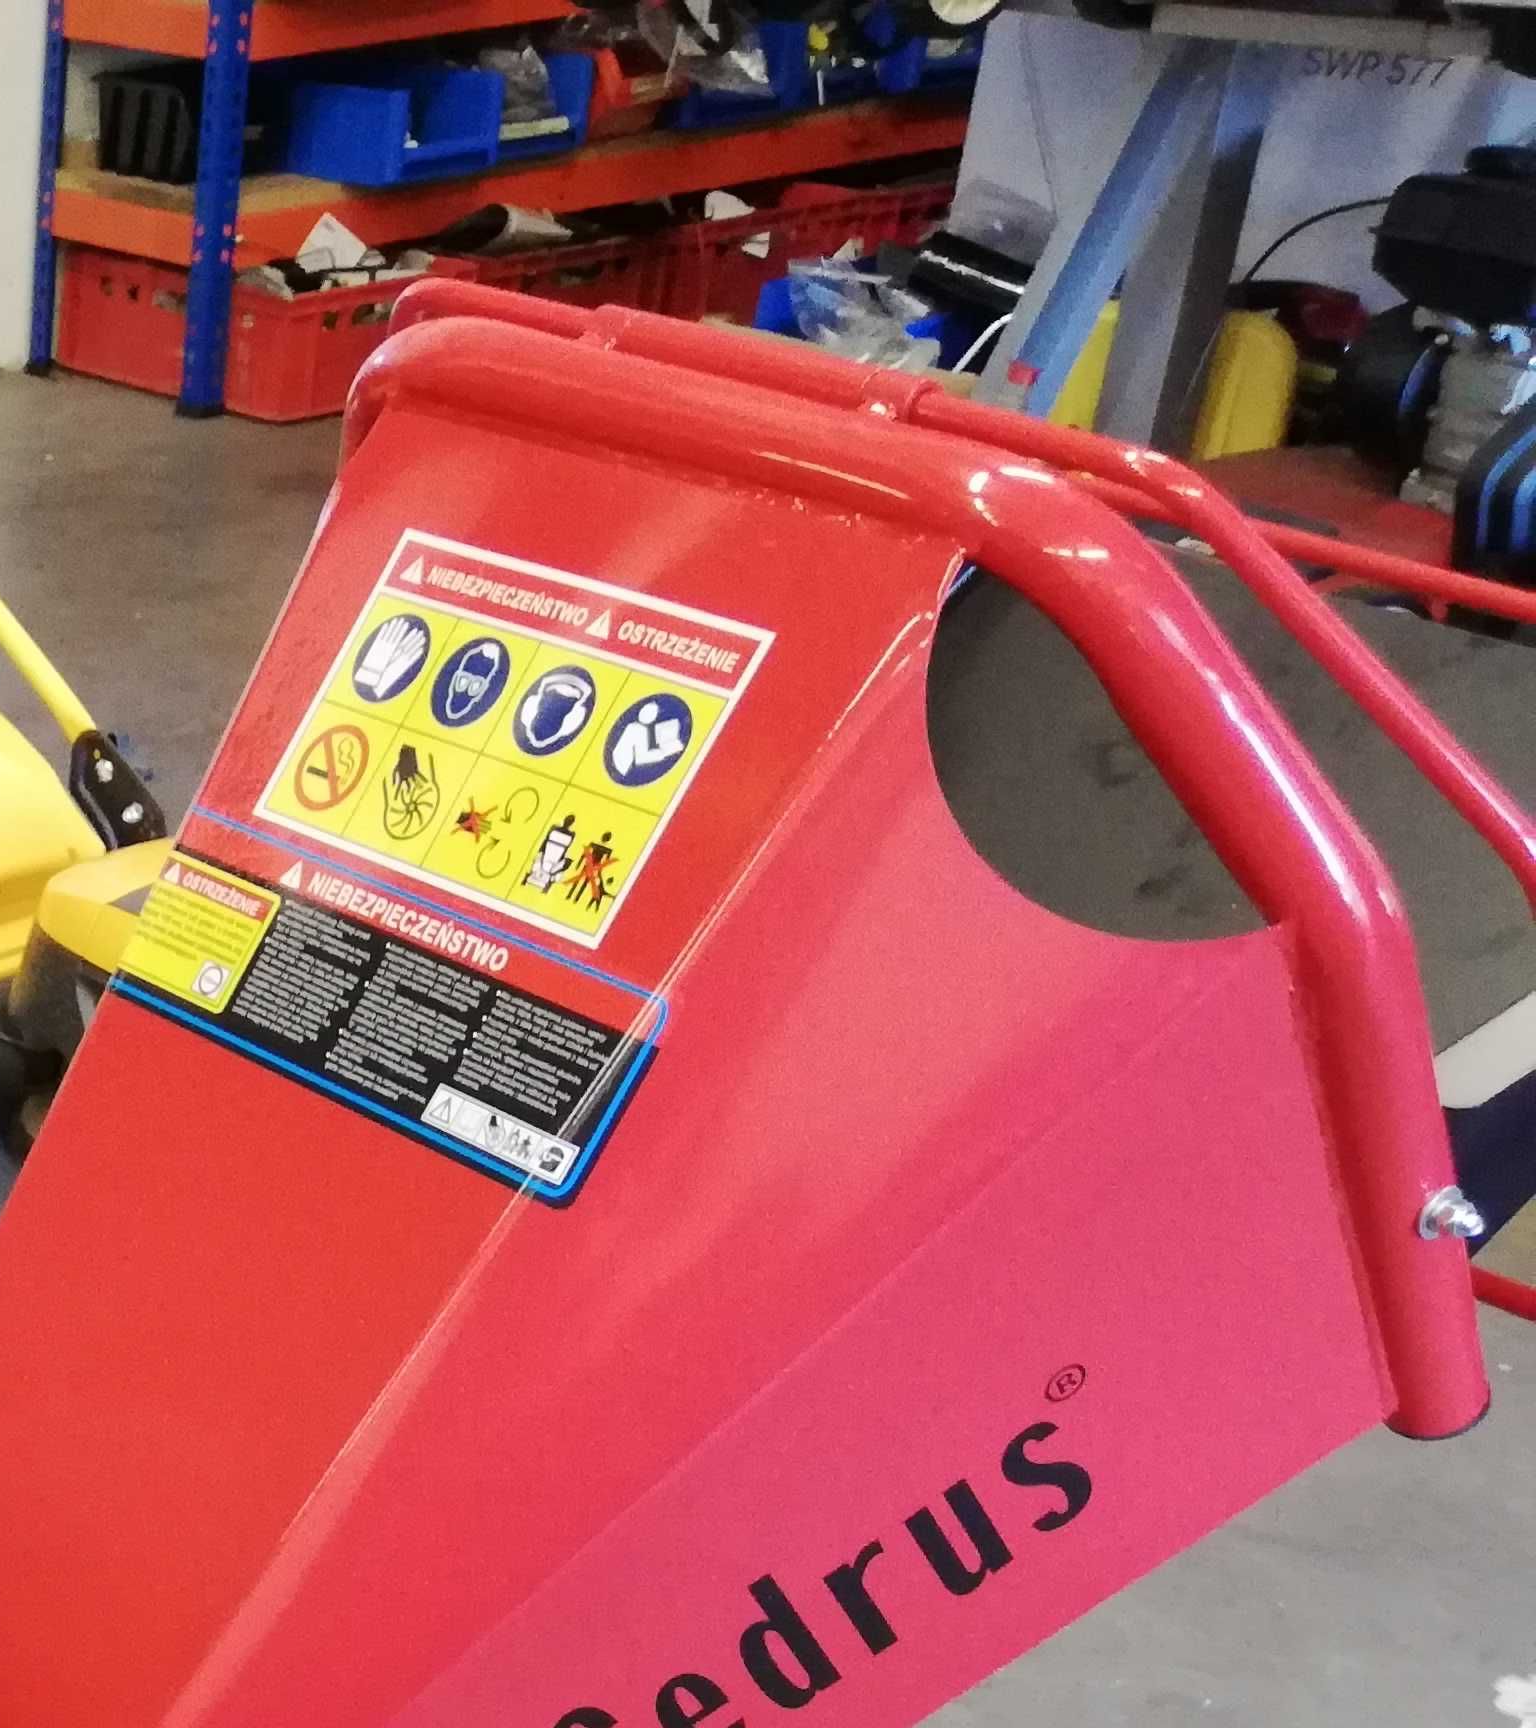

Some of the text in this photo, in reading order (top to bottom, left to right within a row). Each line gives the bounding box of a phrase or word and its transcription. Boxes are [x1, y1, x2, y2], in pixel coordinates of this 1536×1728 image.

[426, 564, 741, 674] NIEBEZPIECZEŃSTWO OSTRZEŻENIE
[307, 870, 510, 973] NIEBEZPIECZEŃSTWO
